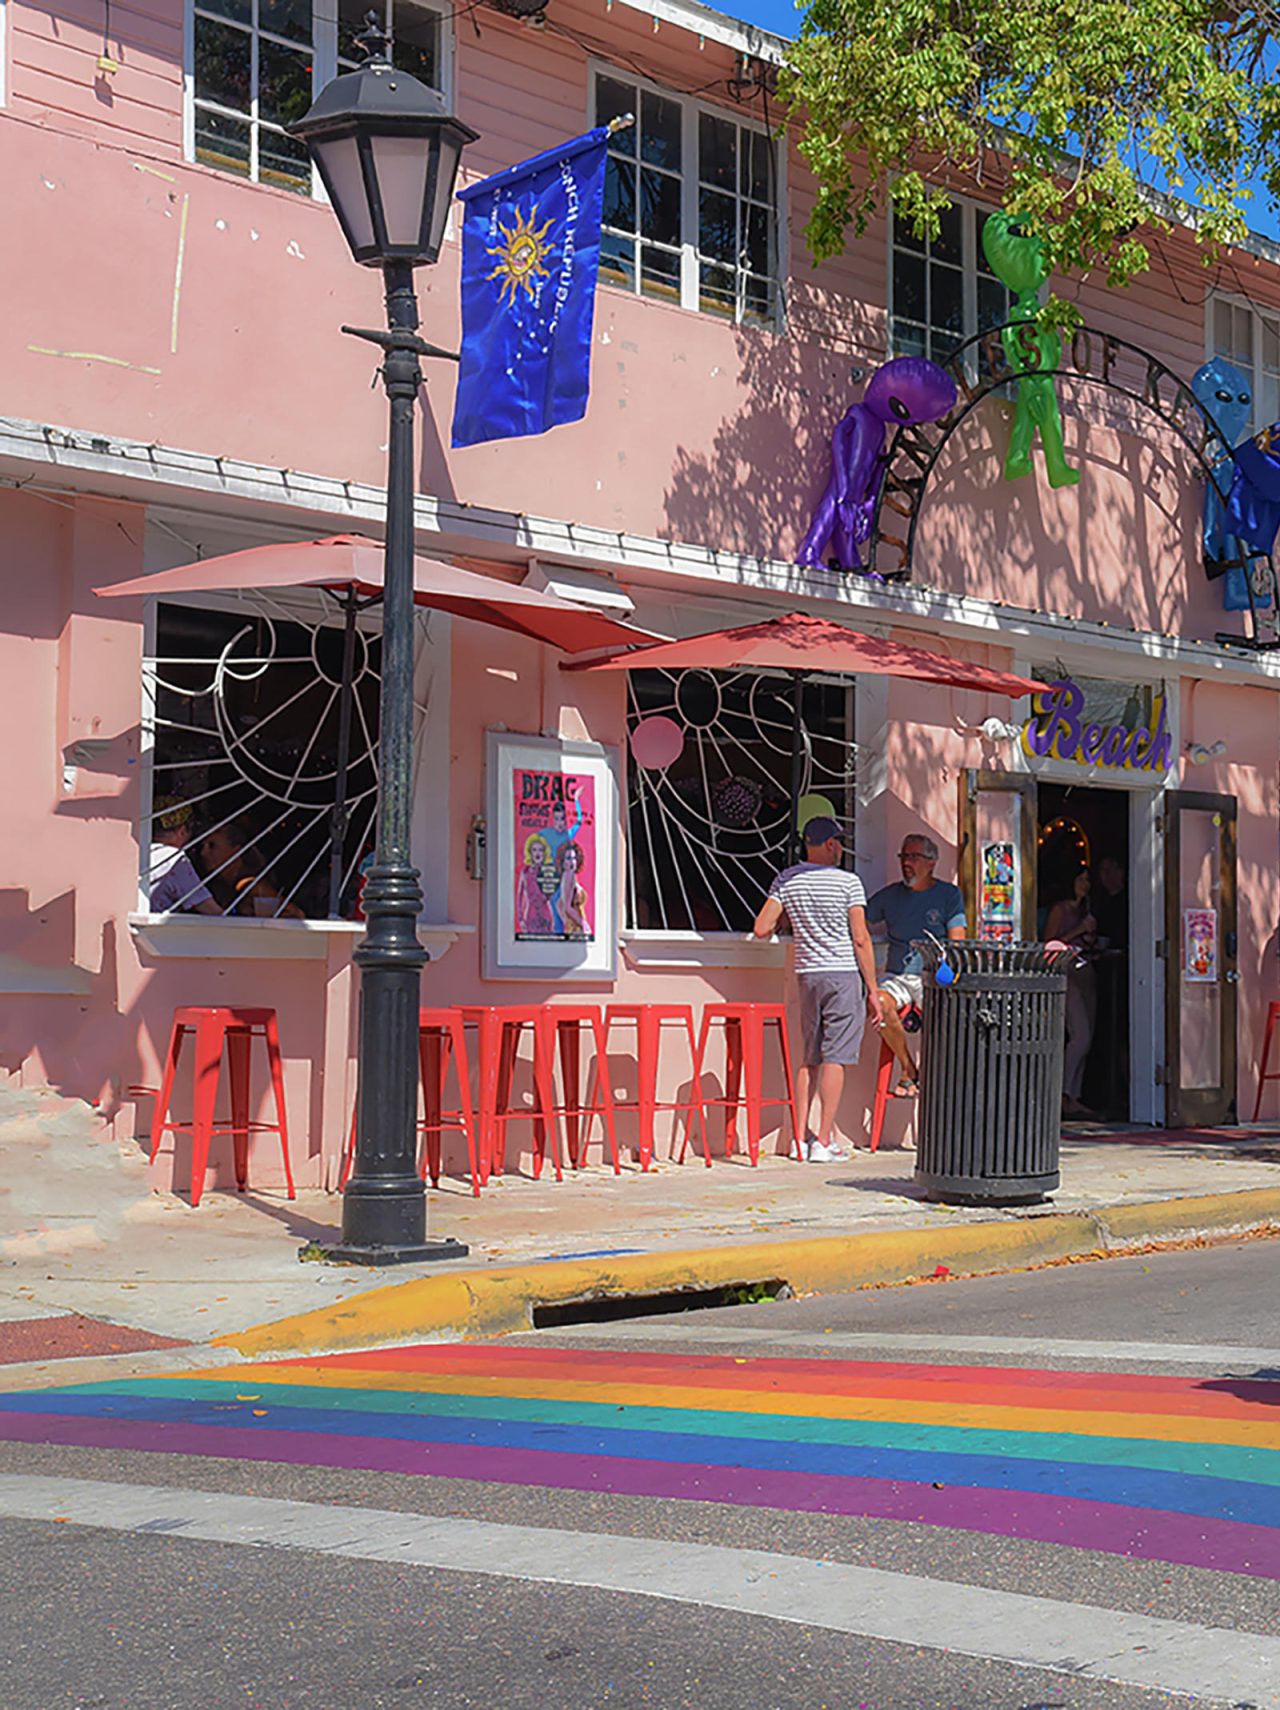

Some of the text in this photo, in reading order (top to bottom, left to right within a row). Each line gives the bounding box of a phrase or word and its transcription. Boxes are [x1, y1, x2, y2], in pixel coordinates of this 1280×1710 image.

[1071, 331, 1120, 382] OF
[1022, 677, 1174, 772] Beach
[521, 773, 578, 803] DRAG
